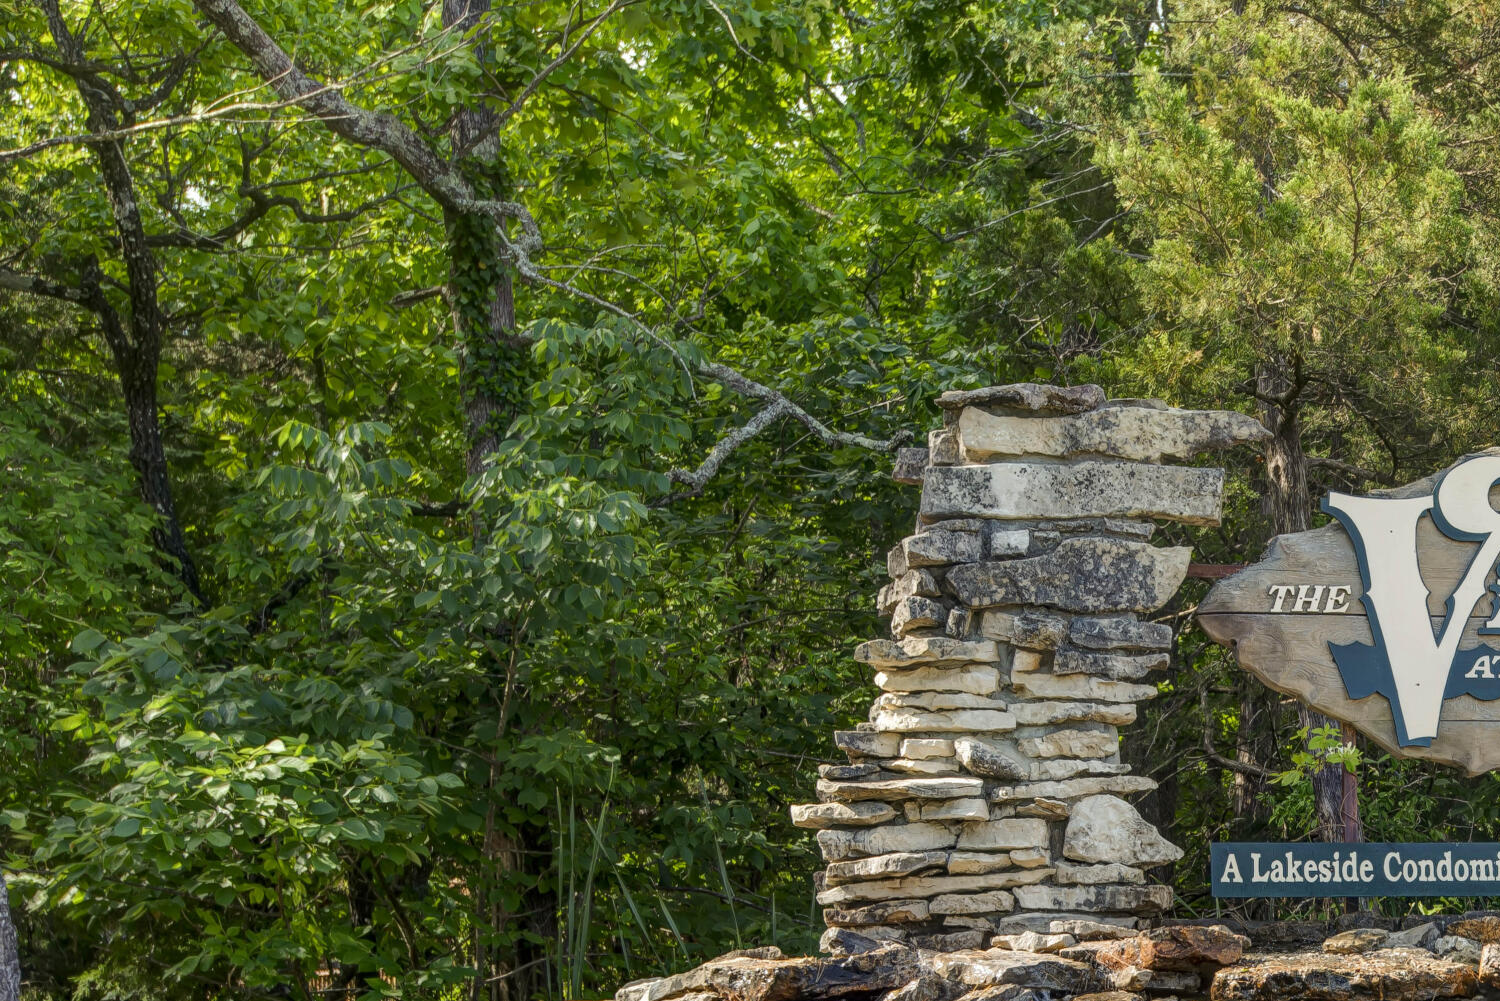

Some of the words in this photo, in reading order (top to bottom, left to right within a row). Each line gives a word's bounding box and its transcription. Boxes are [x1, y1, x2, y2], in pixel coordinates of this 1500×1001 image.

[1267, 584, 1353, 614] THE
[1220, 853, 1243, 883] A
[1251, 851, 1374, 883] Lakeside
